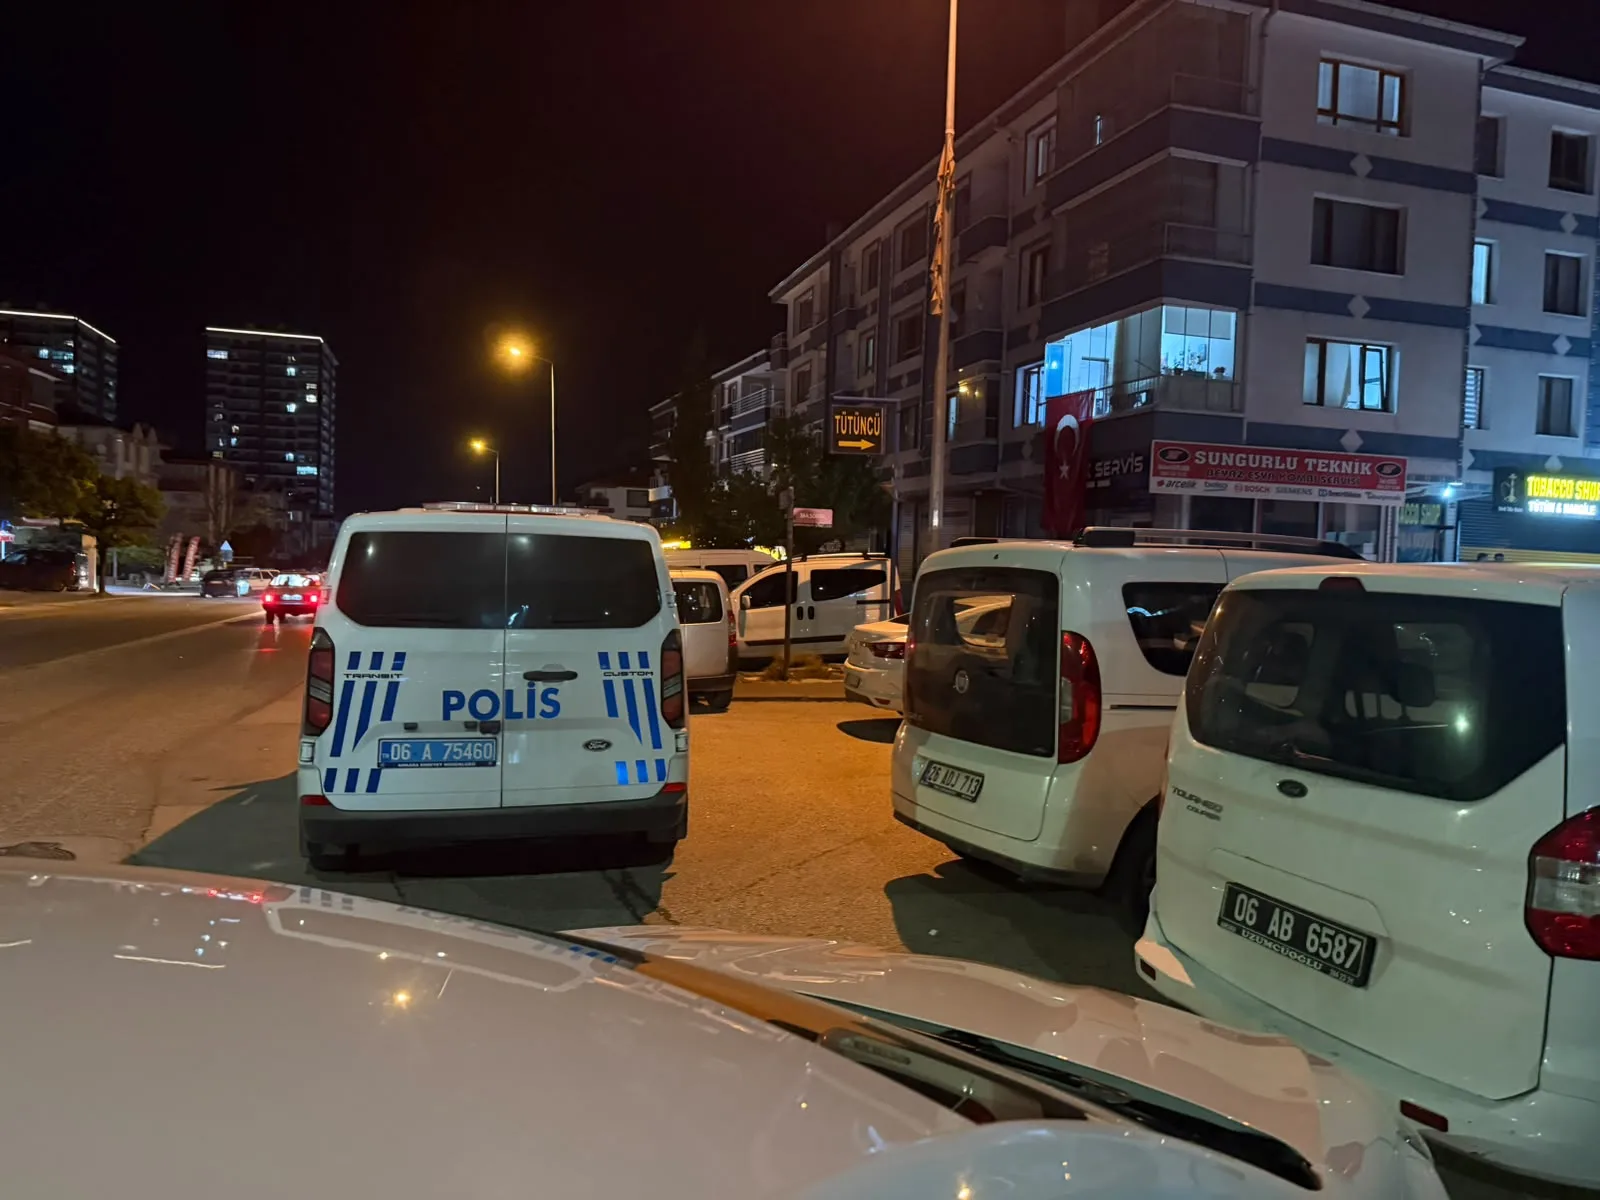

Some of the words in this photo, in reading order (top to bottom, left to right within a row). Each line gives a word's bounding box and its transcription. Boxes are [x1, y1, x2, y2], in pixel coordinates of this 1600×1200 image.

[835, 411, 881, 436] TÜTÜNCÜ
[1095, 451, 1144, 478] SERVİS
[1194, 450, 1298, 471] SUNGURLU
[1305, 457, 1372, 475] TEKNİK
[1527, 476, 1575, 499] TOBACCO
[442, 680, 561, 721] POLİS
[391, 743, 411, 760] 06
[422, 743, 432, 760] A
[442, 742, 493, 760] 75460
[960, 774, 981, 795] 713
[1233, 893, 1259, 926] 06
[1267, 907, 1295, 941] AB
[1305, 923, 1362, 969] 6587
